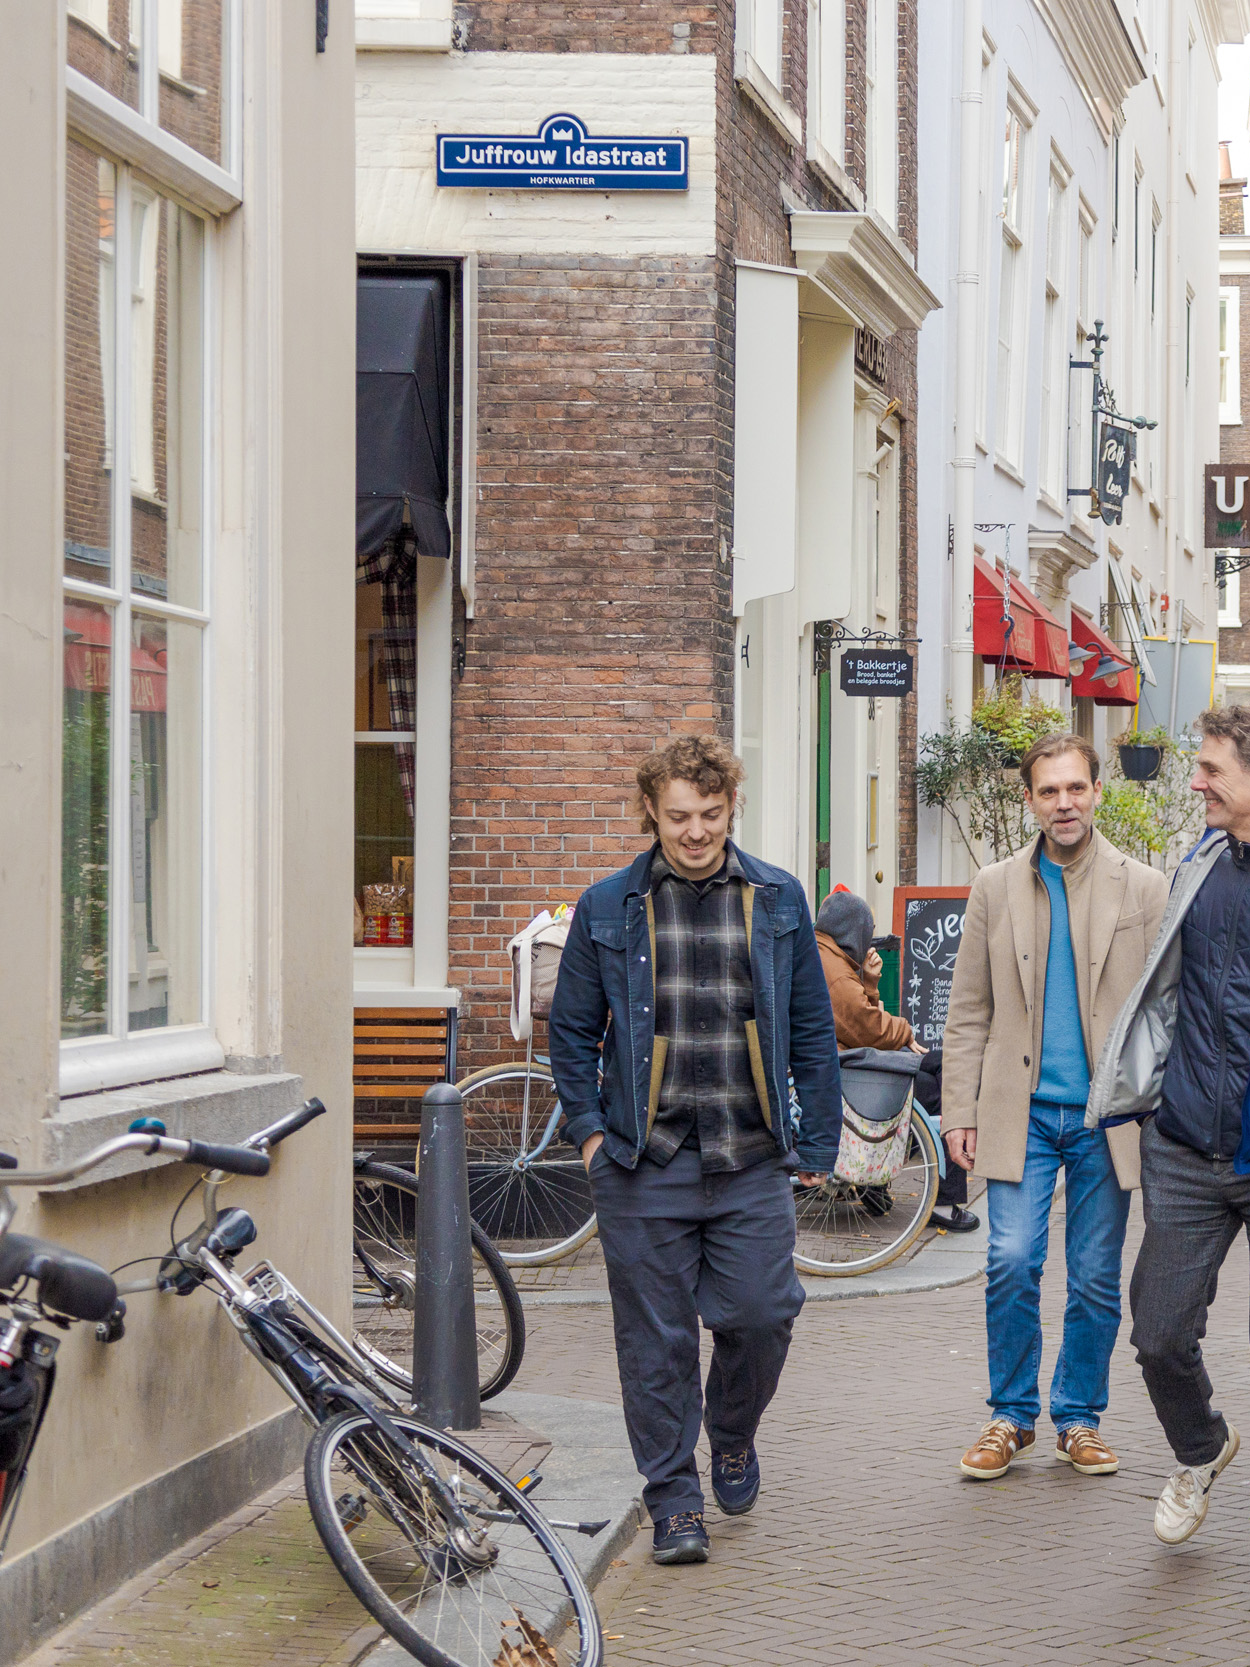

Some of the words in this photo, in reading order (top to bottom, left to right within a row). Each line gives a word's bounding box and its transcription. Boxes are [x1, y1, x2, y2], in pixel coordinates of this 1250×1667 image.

[455, 145, 558, 165] Juffrouw
[565, 146, 667, 166] Idastraat
[529, 176, 596, 186] HOFKWARTIER
[1210, 475, 1250, 514] U
[856, 659, 908, 674] Bakkertje
[855, 677, 879, 686] belegde
[879, 677, 906, 686] broodjes
